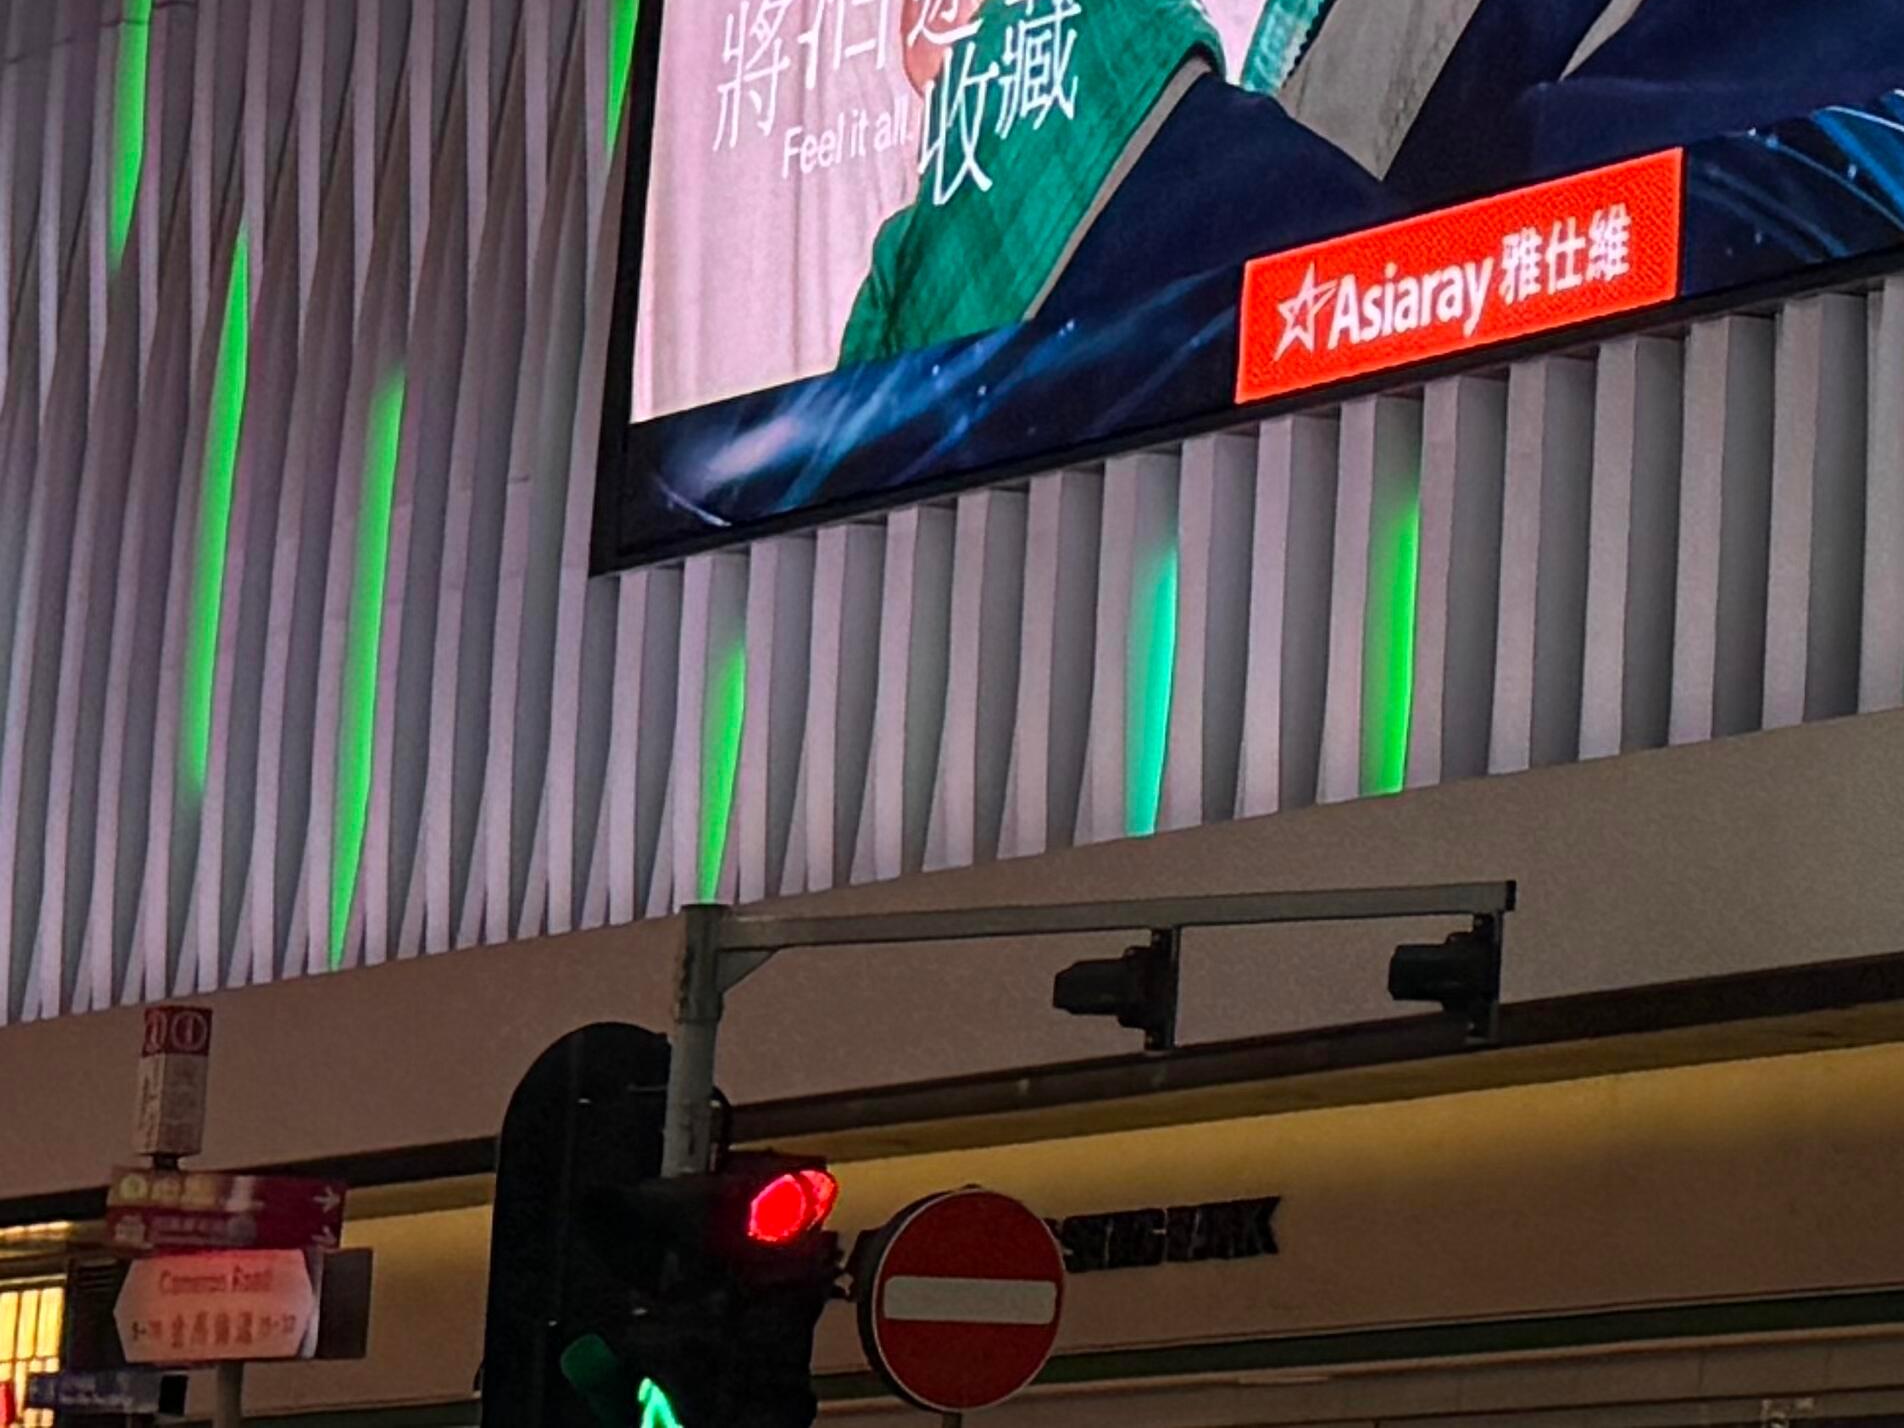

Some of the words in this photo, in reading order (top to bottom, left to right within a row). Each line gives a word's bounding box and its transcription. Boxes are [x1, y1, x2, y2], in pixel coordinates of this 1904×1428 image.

[781, 111, 846, 179] Feel
[850, 108, 869, 158] it
[1328, 255, 1494, 350] Asiaray
[1500, 203, 1632, 304] 雅仕維
